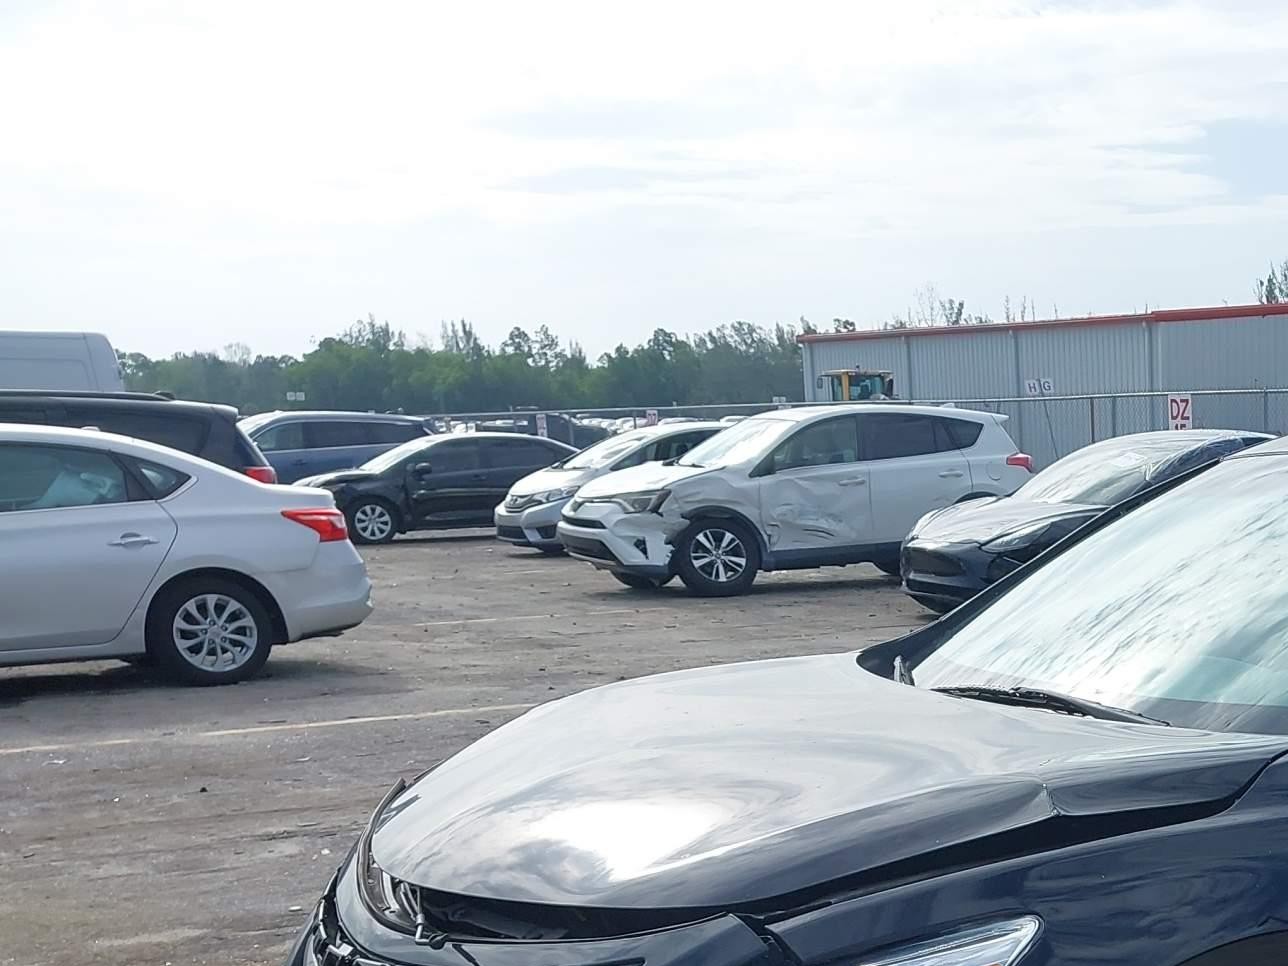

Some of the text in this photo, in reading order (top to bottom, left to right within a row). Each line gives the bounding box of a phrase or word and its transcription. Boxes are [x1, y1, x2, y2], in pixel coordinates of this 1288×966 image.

[1028, 382, 1037, 393] H
[1042, 381, 1051, 391] G
[1170, 399, 1190, 420] DZ
